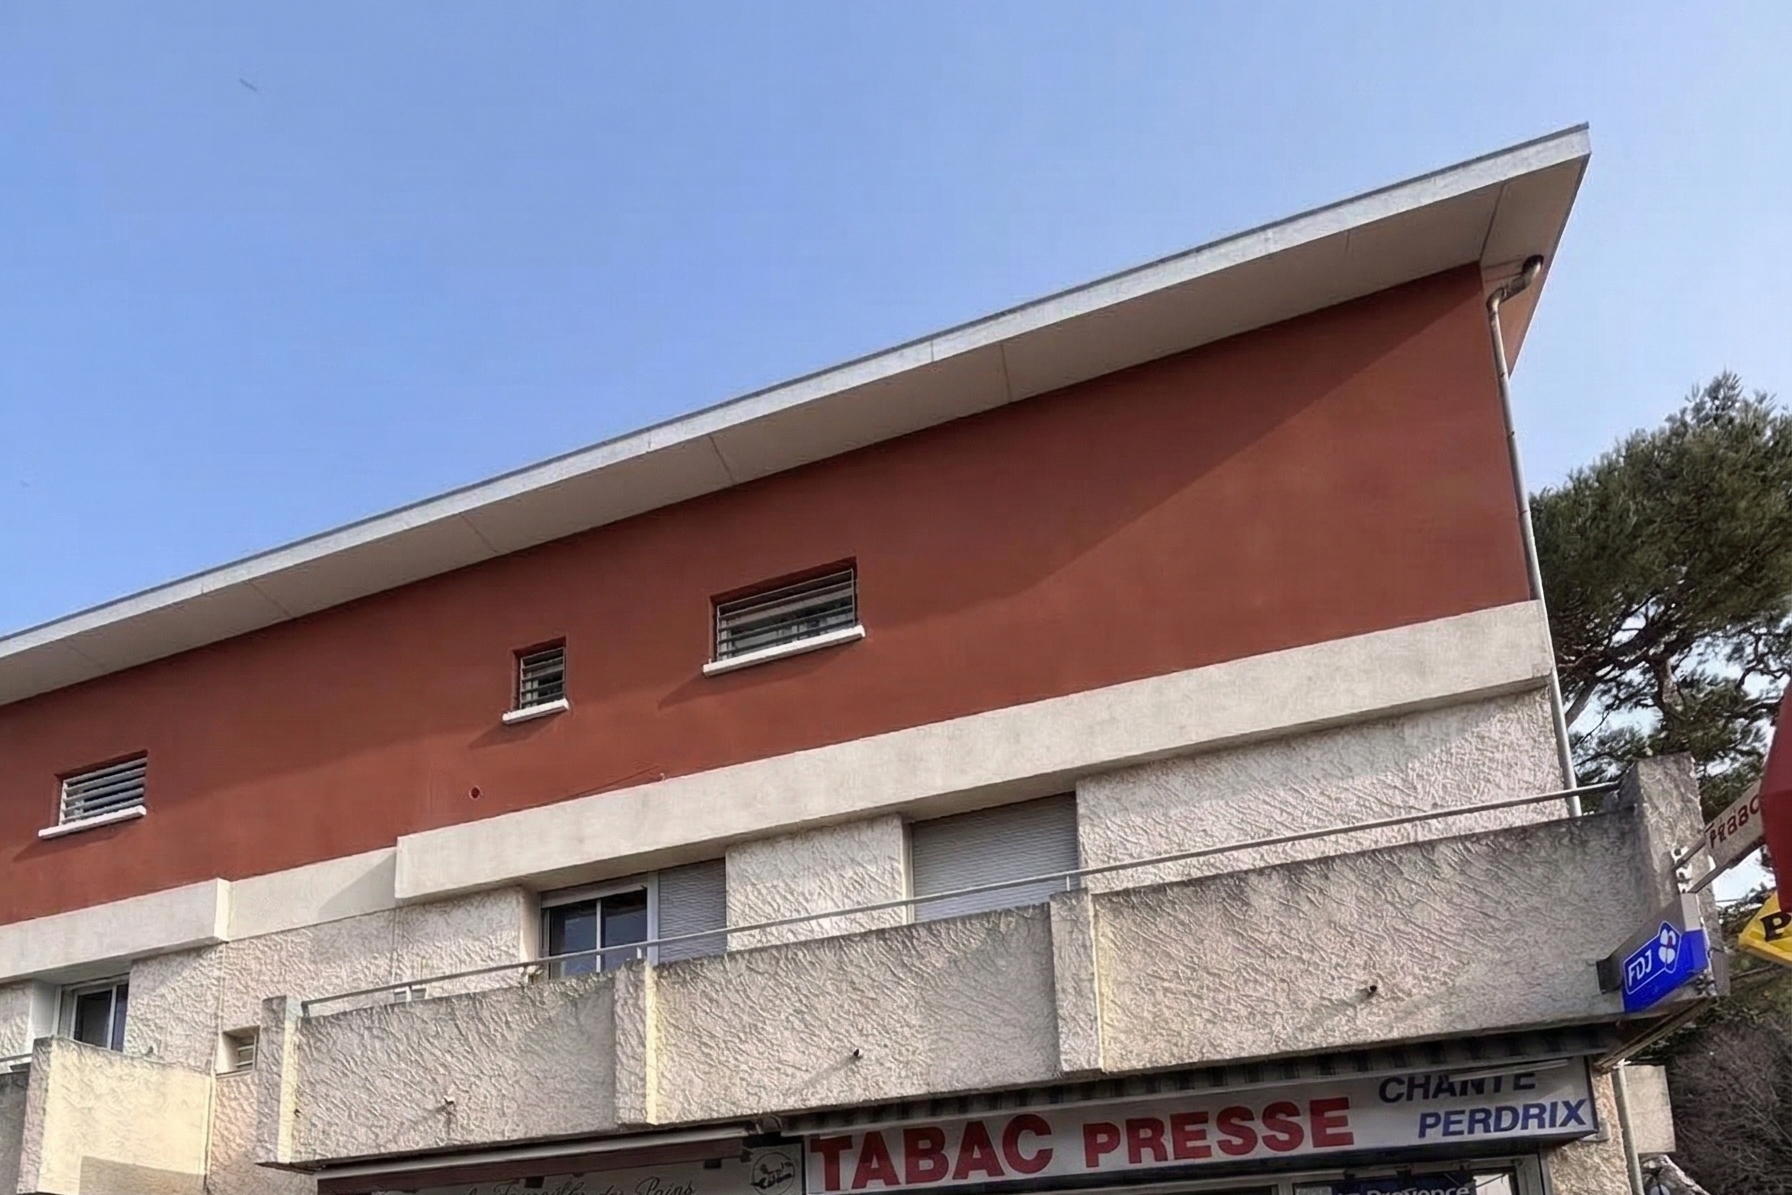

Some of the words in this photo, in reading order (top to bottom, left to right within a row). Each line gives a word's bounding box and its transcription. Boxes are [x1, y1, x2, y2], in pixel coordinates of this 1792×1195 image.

[1627, 949, 1653, 987] FDJ
[1418, 1098, 1588, 1138] PERDRIX
[809, 1113, 1054, 1192] TABAC
[1084, 1097, 1354, 1168] PRESSE
